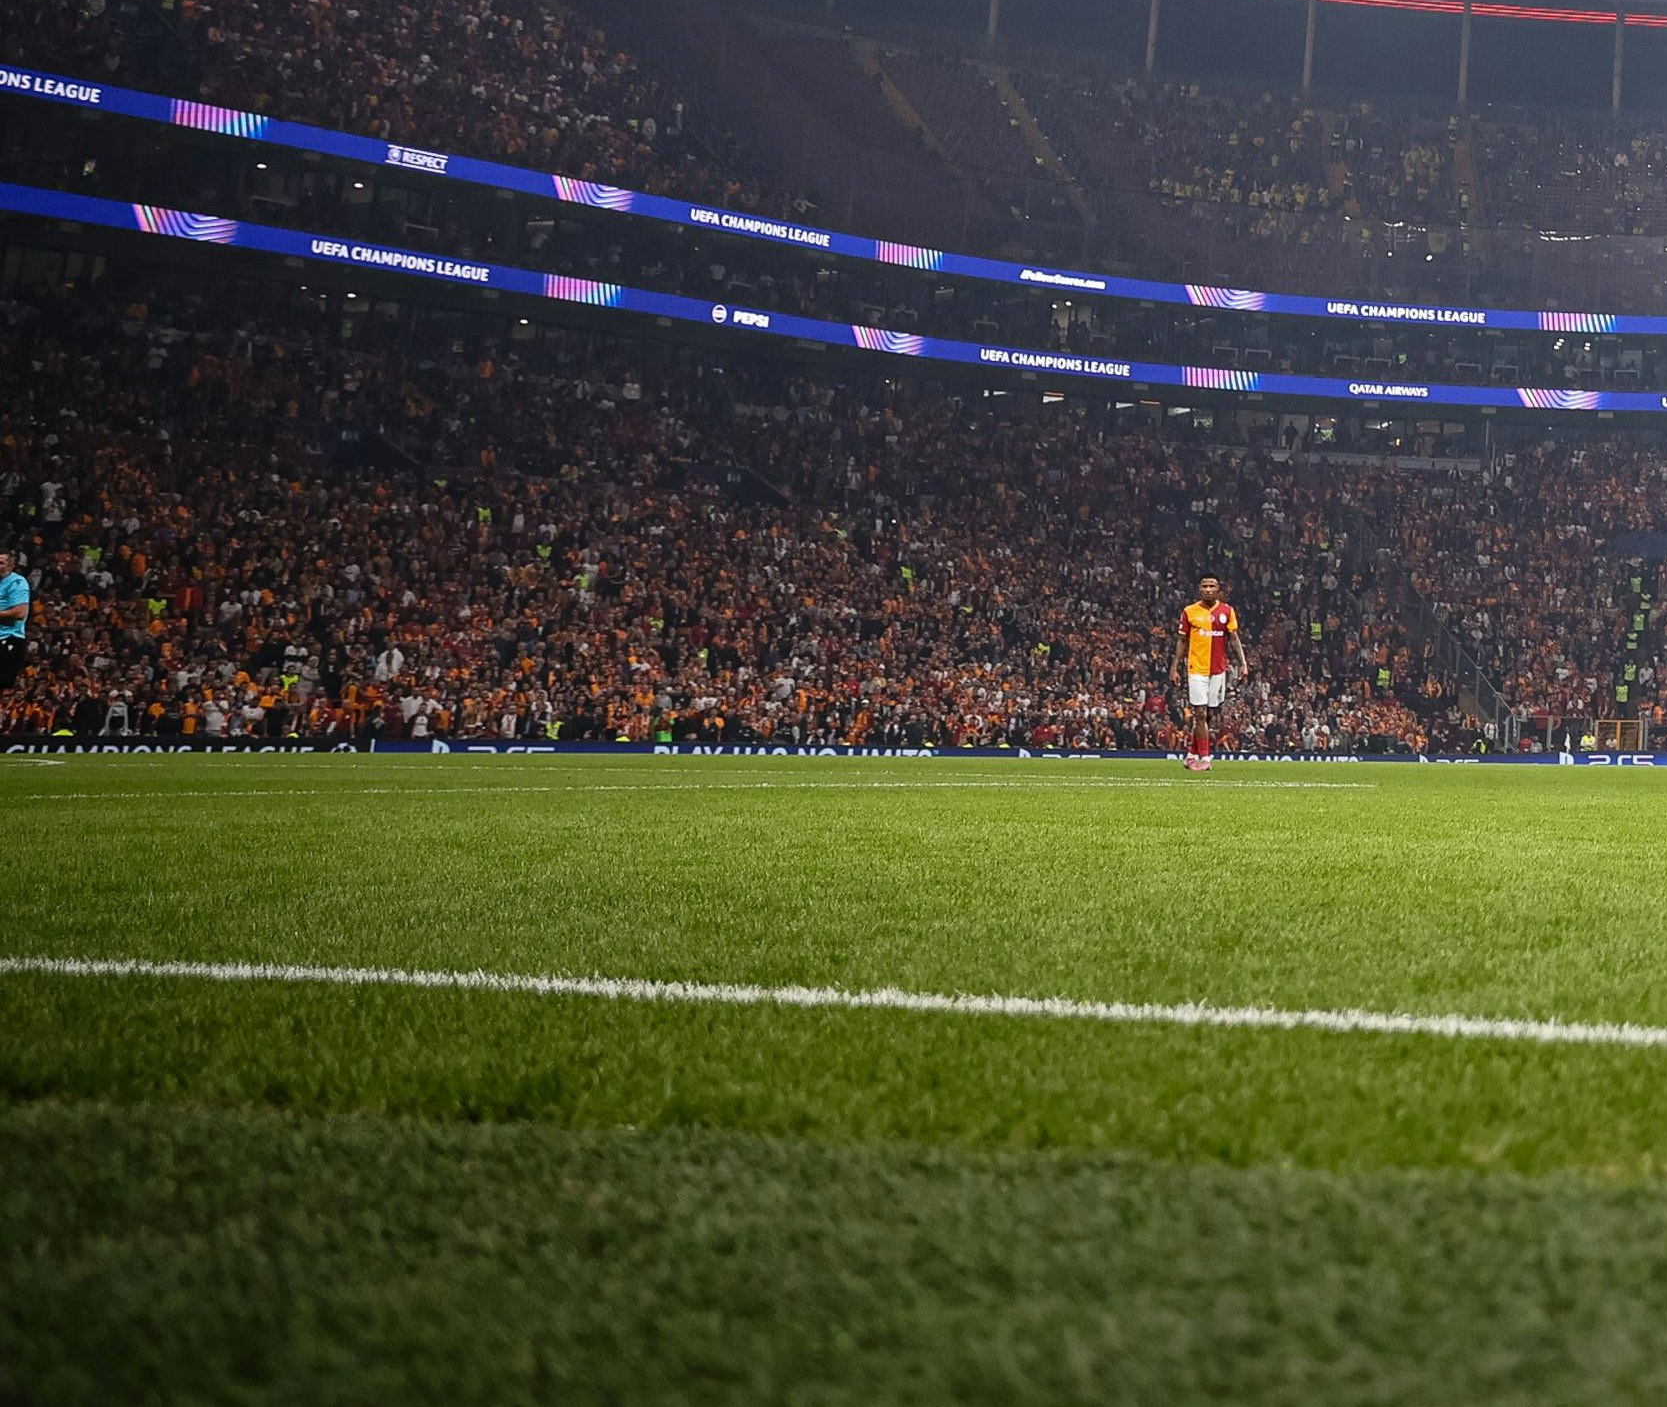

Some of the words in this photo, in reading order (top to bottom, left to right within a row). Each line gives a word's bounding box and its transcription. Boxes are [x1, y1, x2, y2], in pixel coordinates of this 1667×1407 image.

[34, 78, 101, 103] LEAGUE
[403, 150, 447, 170] RESPECT
[690, 209, 720, 225] UEFA
[721, 215, 787, 238] CHAMPIONS
[788, 229, 830, 247] LEAGUE
[312, 240, 348, 258] UEFA
[351, 247, 435, 272] CHAMPIONS
[436, 262, 489, 282] LEAGUE
[733, 311, 769, 328] PEPSI
[1327, 302, 1358, 315] UEFA
[1361, 305, 1435, 320] CHAMPIONS
[1437, 310, 1485, 324] LEAGUE
[980, 348, 1010, 363] UEFA
[1011, 352, 1082, 371] CHAMPIONS
[1084, 361, 1130, 376] LEAGUE
[1348, 383, 1383, 395] QATAR
[1385, 385, 1428, 397] AIRWAYS
